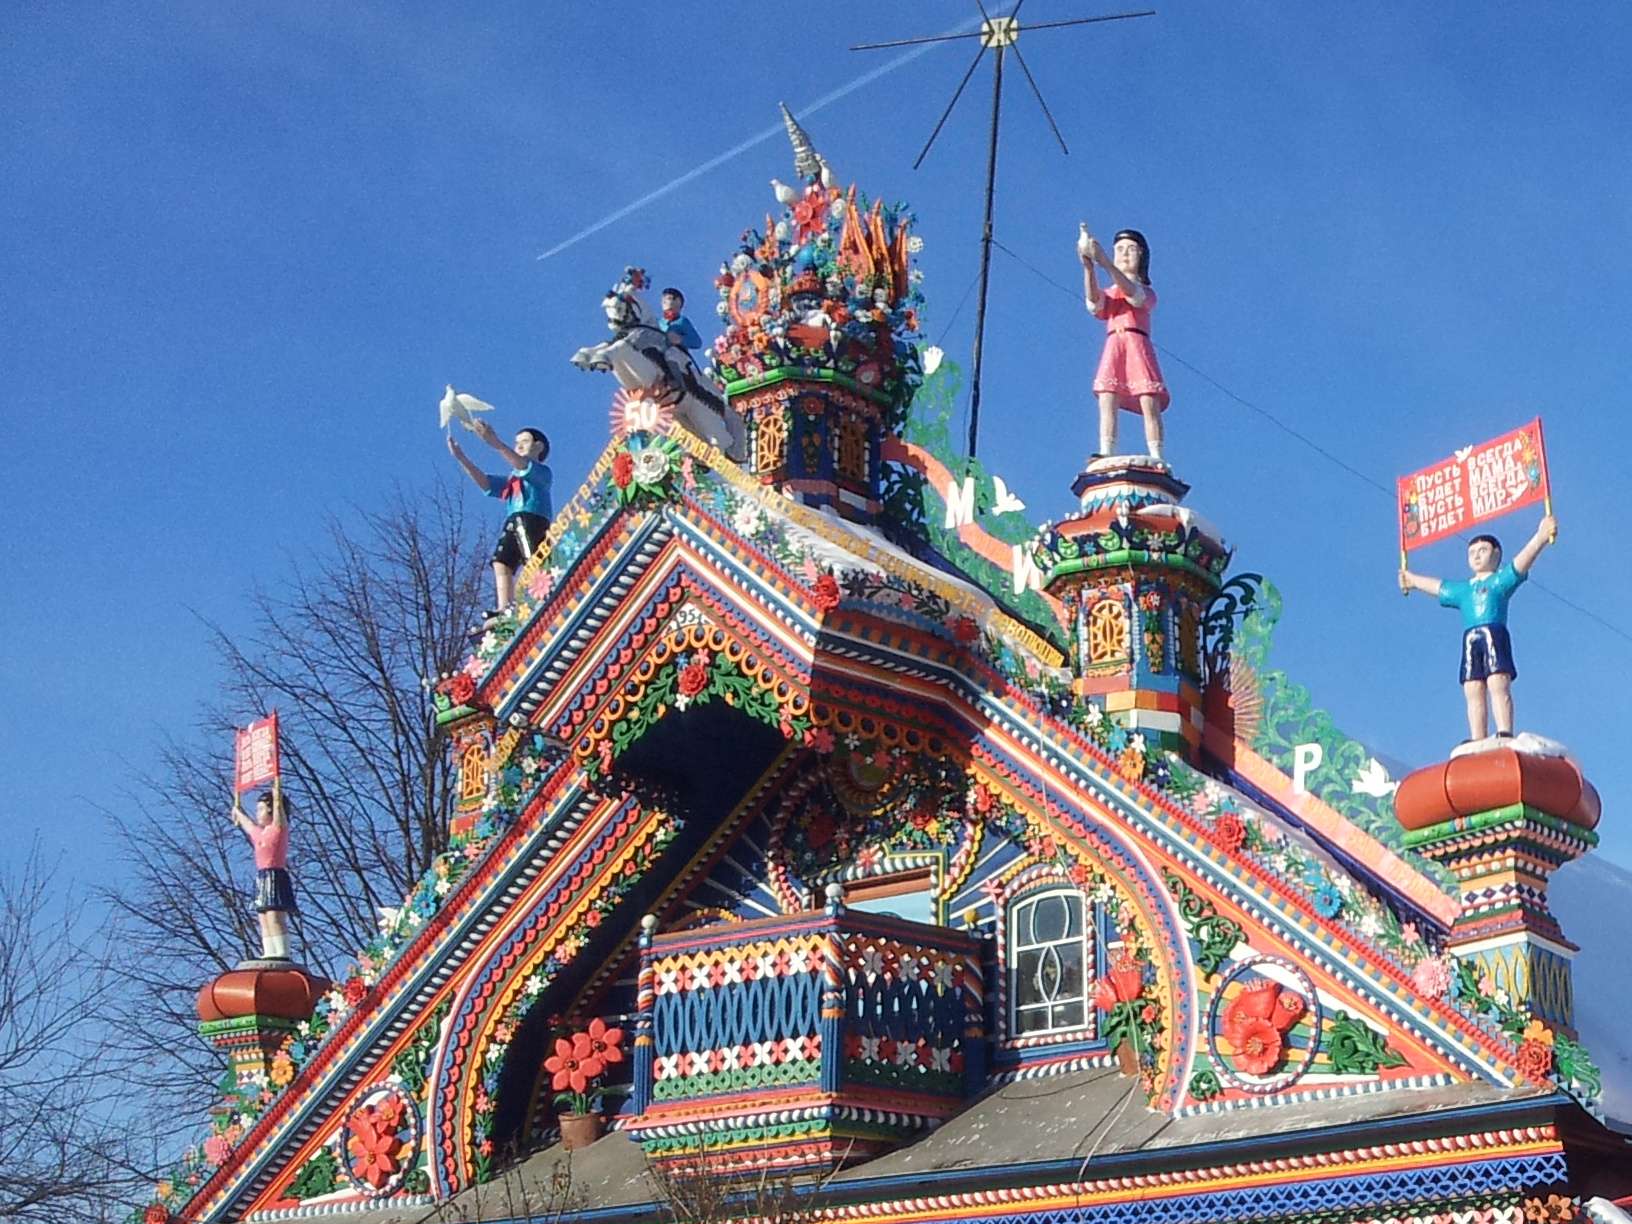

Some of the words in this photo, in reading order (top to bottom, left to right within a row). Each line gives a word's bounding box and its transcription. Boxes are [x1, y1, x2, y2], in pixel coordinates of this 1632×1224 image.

[624, 398, 657, 431] 50
[1416, 464, 1462, 493] ПУСТЬ
[1467, 438, 1522, 471] ВСЕГДА
[1418, 479, 1462, 506] БУДЕТ
[1419, 494, 1464, 522] ПУСТЬ
[1420, 508, 1465, 537] БУДЕТ
